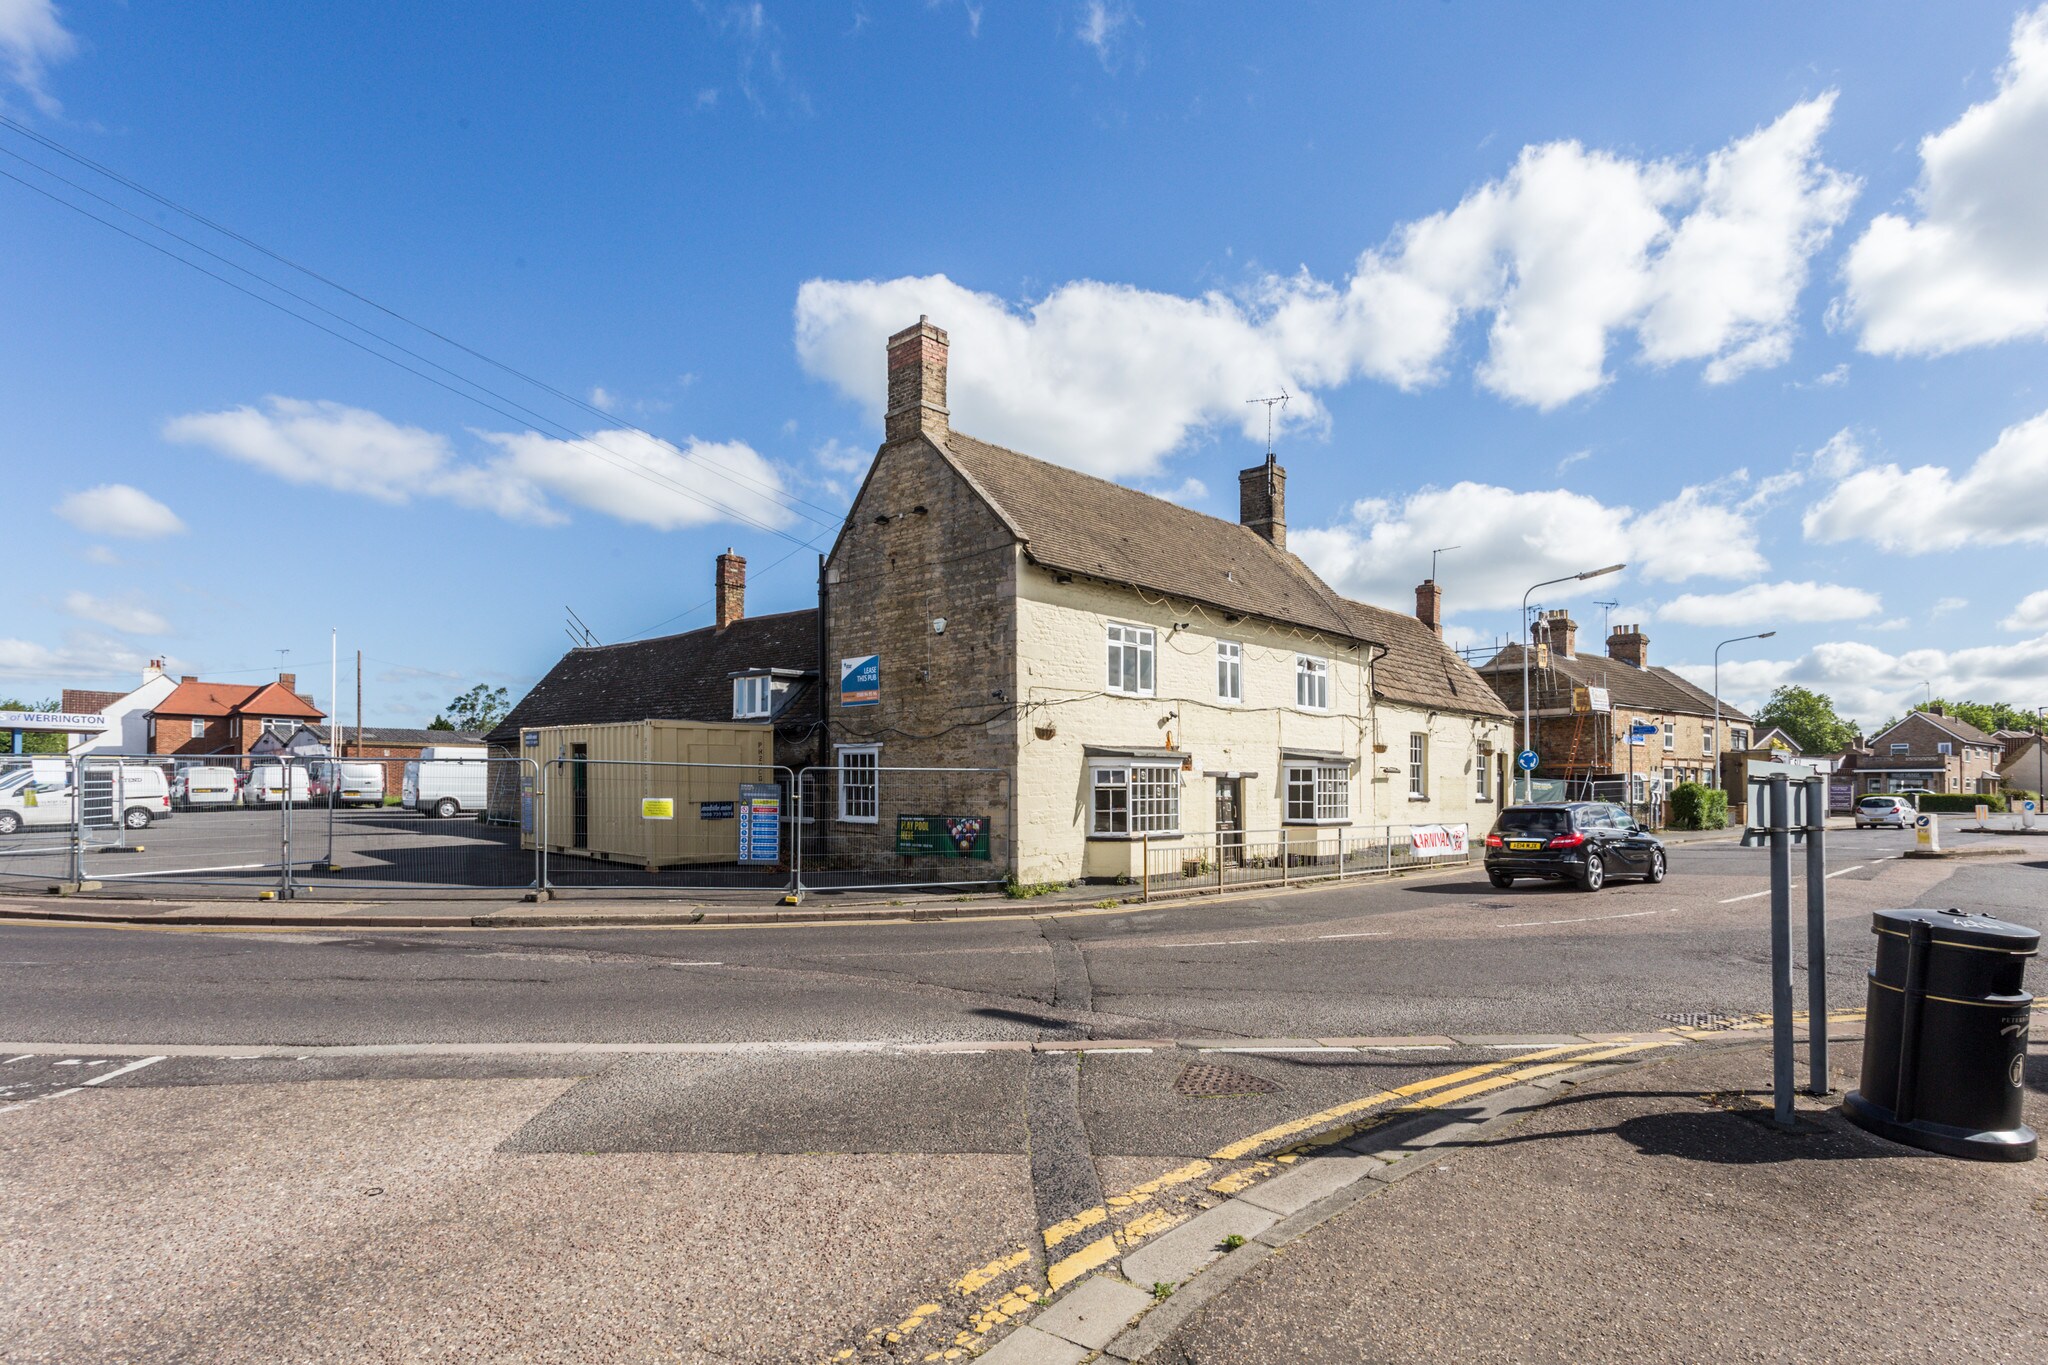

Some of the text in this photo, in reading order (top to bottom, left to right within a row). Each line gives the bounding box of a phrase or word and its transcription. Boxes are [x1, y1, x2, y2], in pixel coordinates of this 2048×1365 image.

[864, 666, 877, 674] LEASE
[10, 713, 21, 722] of
[24, 713, 105, 724] WERRINGTON
[1413, 832, 1449, 849] CARNIVAL
